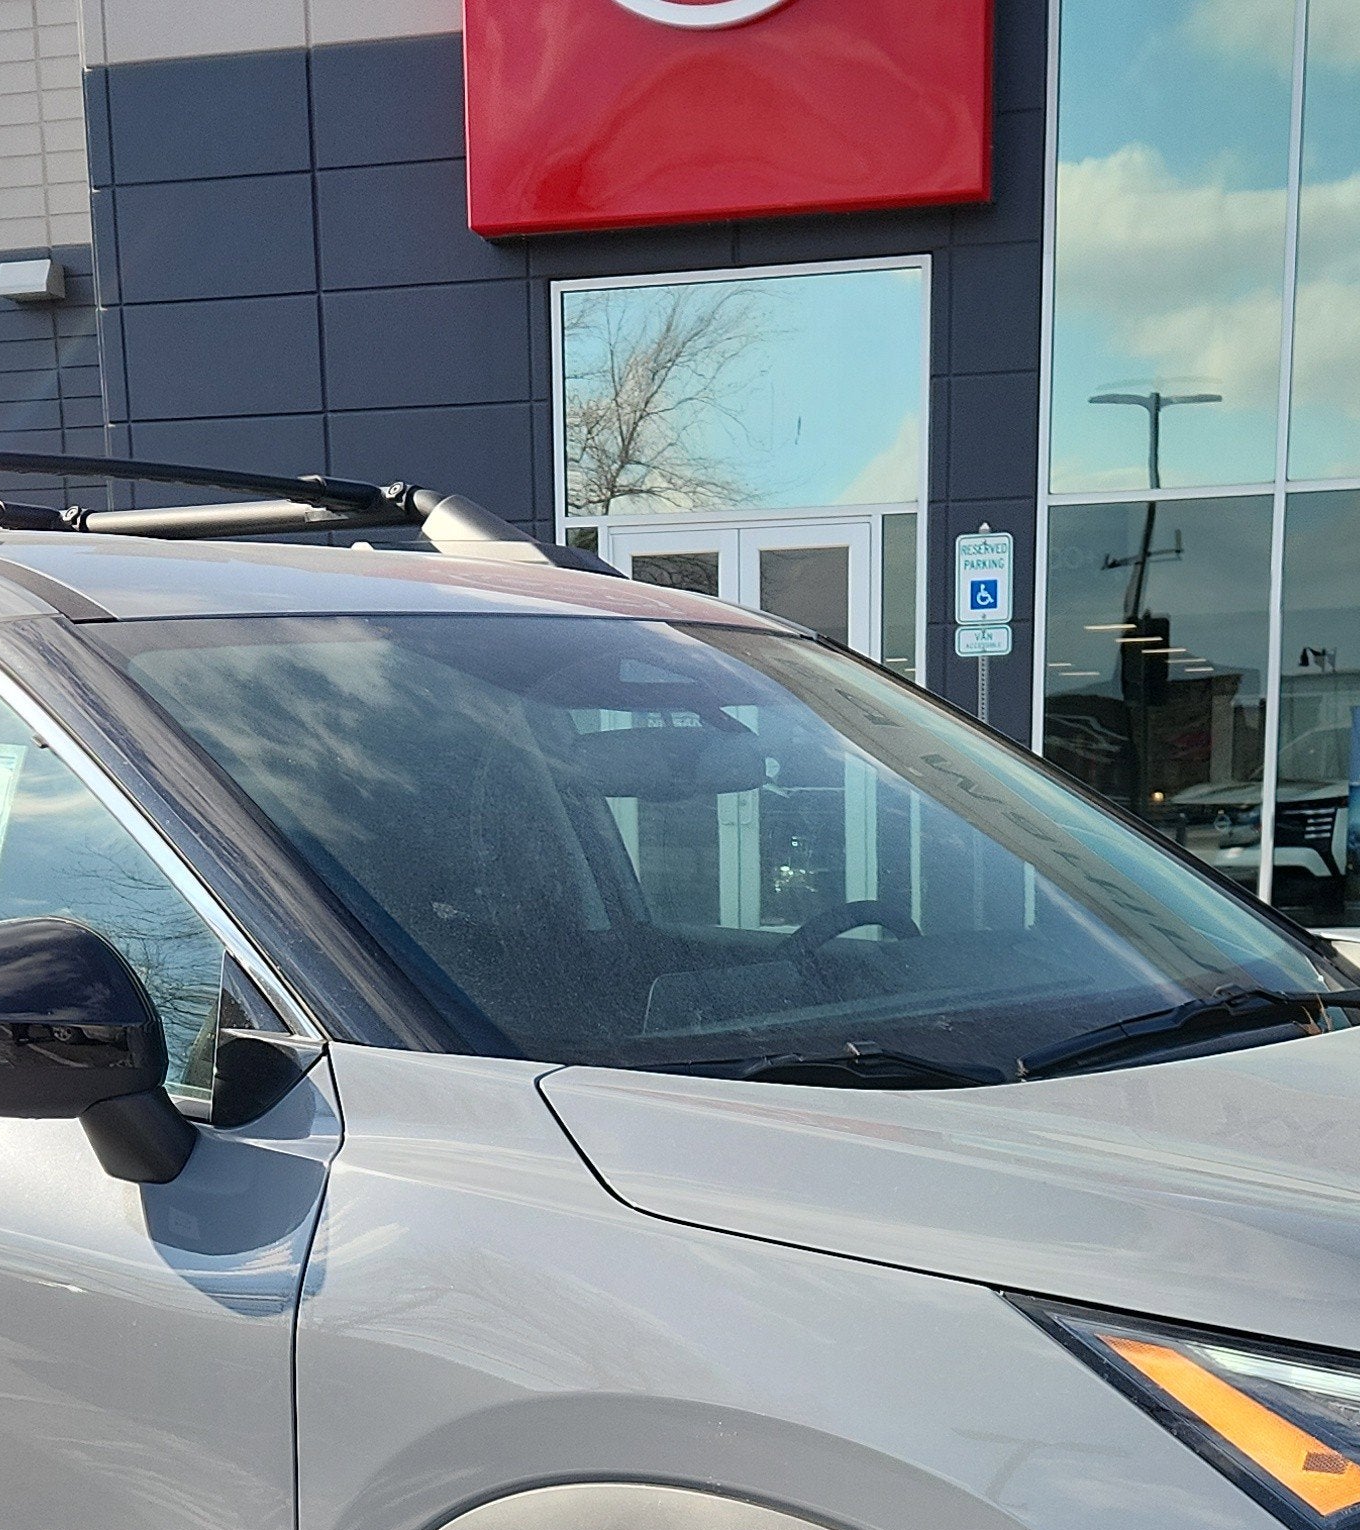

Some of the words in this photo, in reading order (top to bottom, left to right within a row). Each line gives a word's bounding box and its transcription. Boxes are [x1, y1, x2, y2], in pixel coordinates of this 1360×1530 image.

[960, 542, 1008, 556] RESERVED
[963, 558, 1005, 570] PARKING
[974, 631, 994, 641] VAN
